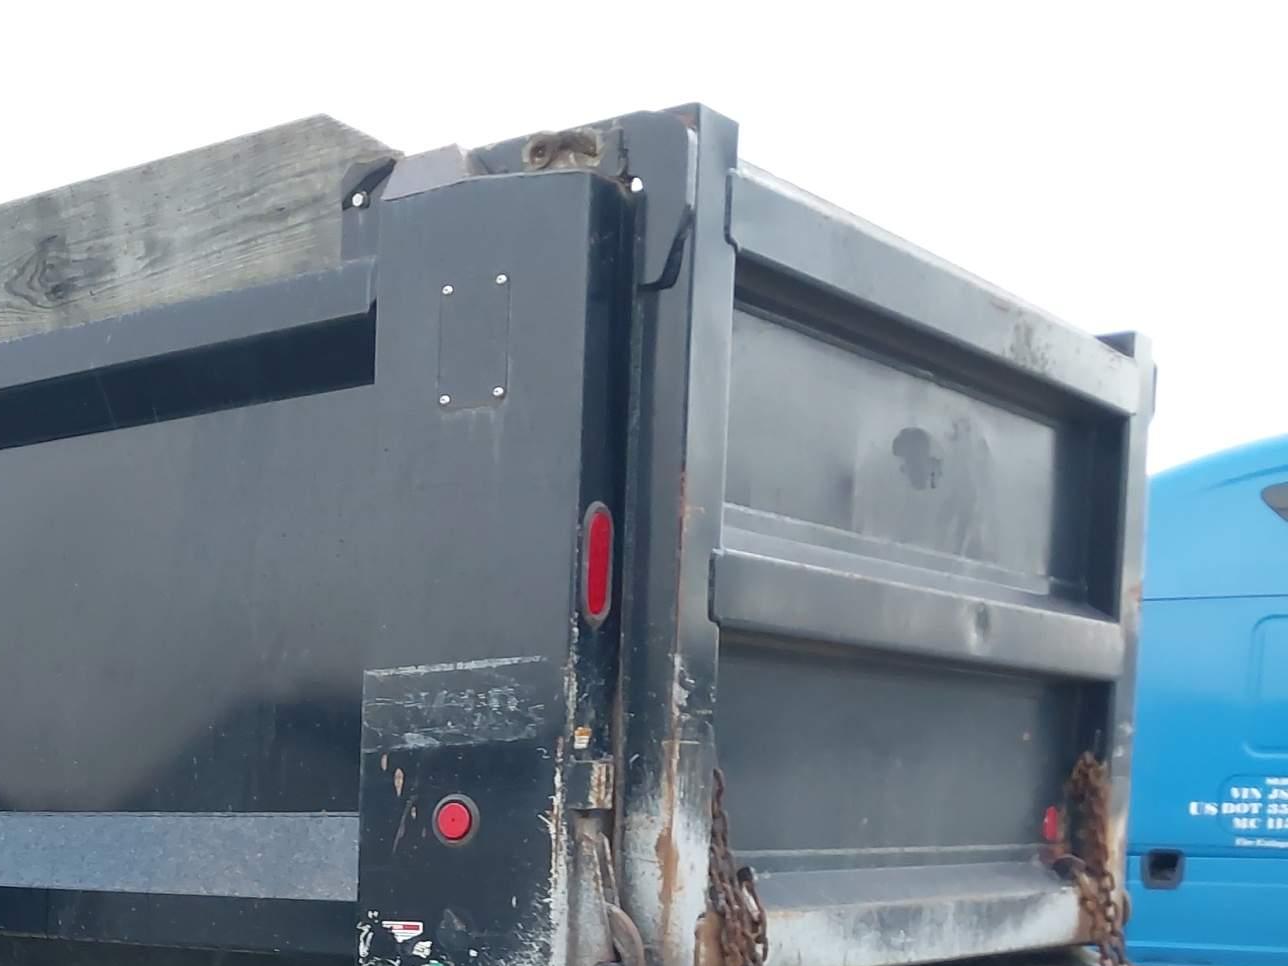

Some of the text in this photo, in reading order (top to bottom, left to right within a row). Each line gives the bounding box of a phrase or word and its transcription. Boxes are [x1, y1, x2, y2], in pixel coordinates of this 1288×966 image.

[1189, 801, 1218, 815] US
[1221, 802, 1262, 814] DOT
[1233, 817, 1260, 829] MC
